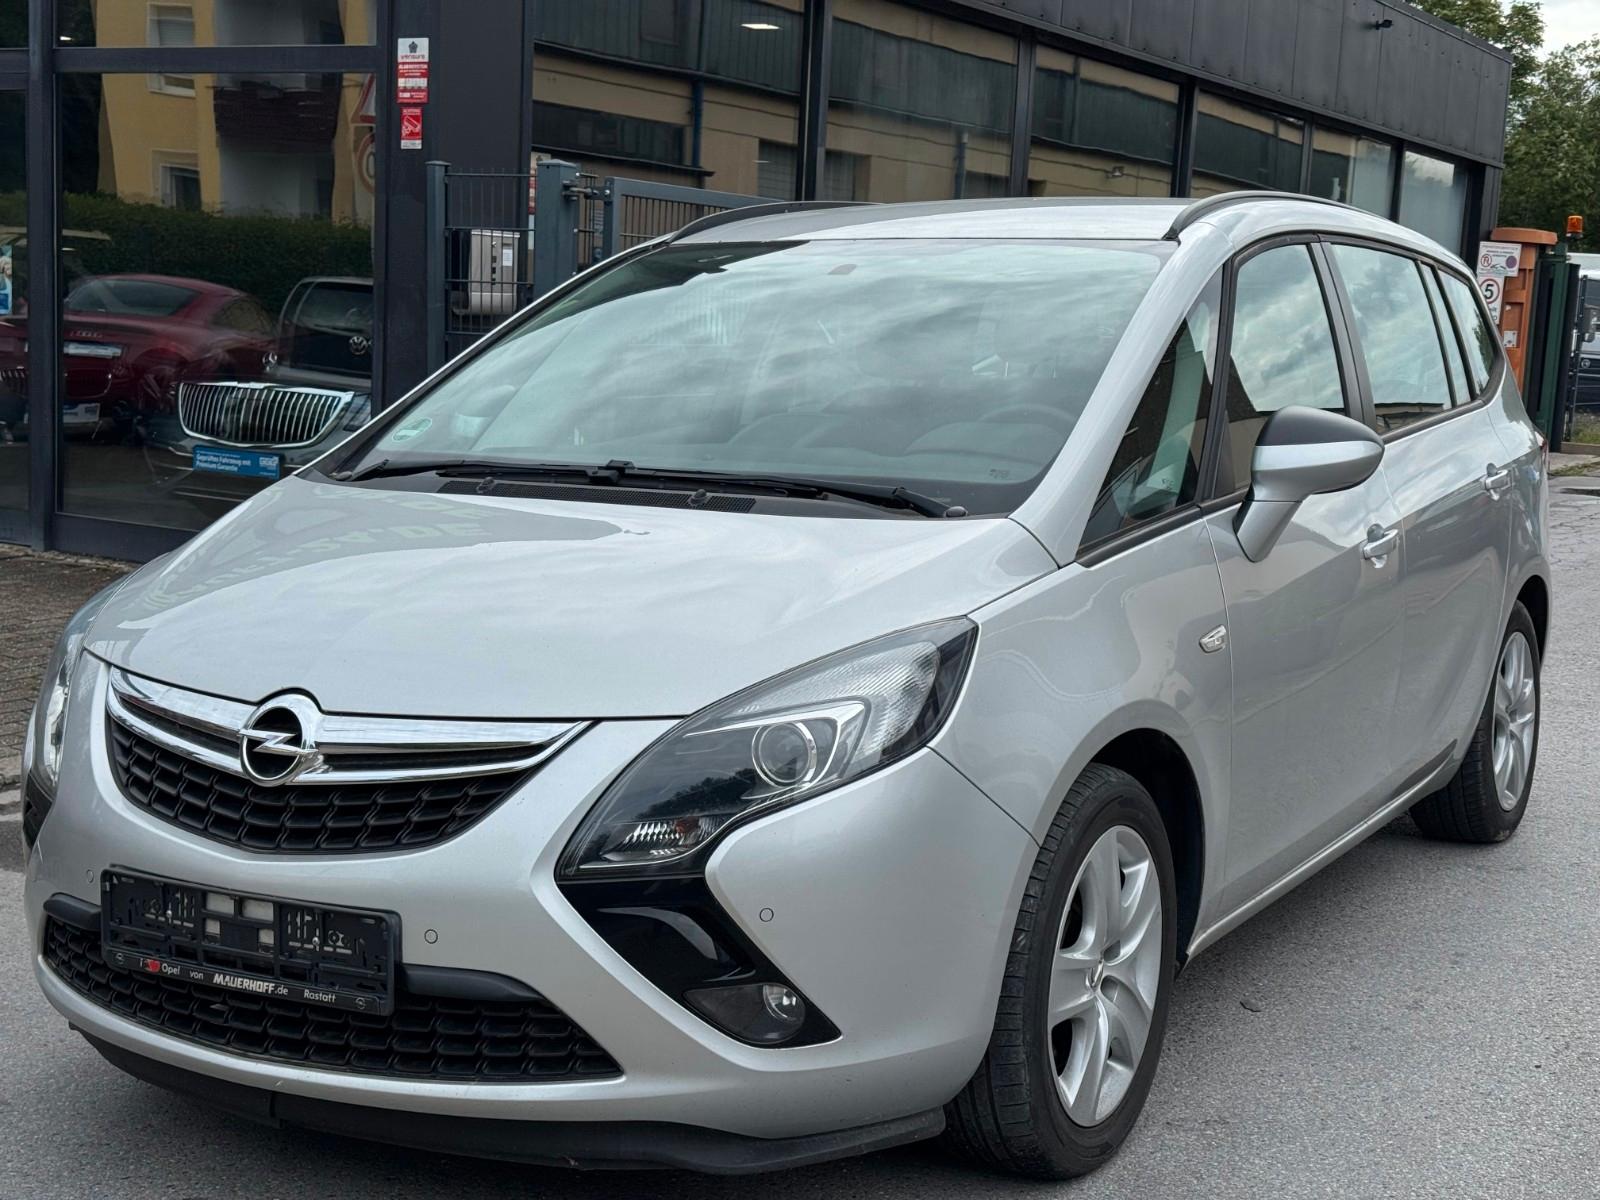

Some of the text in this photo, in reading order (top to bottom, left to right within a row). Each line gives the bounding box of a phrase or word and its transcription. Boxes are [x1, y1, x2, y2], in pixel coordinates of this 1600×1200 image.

[1484, 283, 1495, 300] 5
[161, 963, 181, 975] Opel
[189, 970, 204, 980] von
[303, 988, 336, 1003] Rastatt
